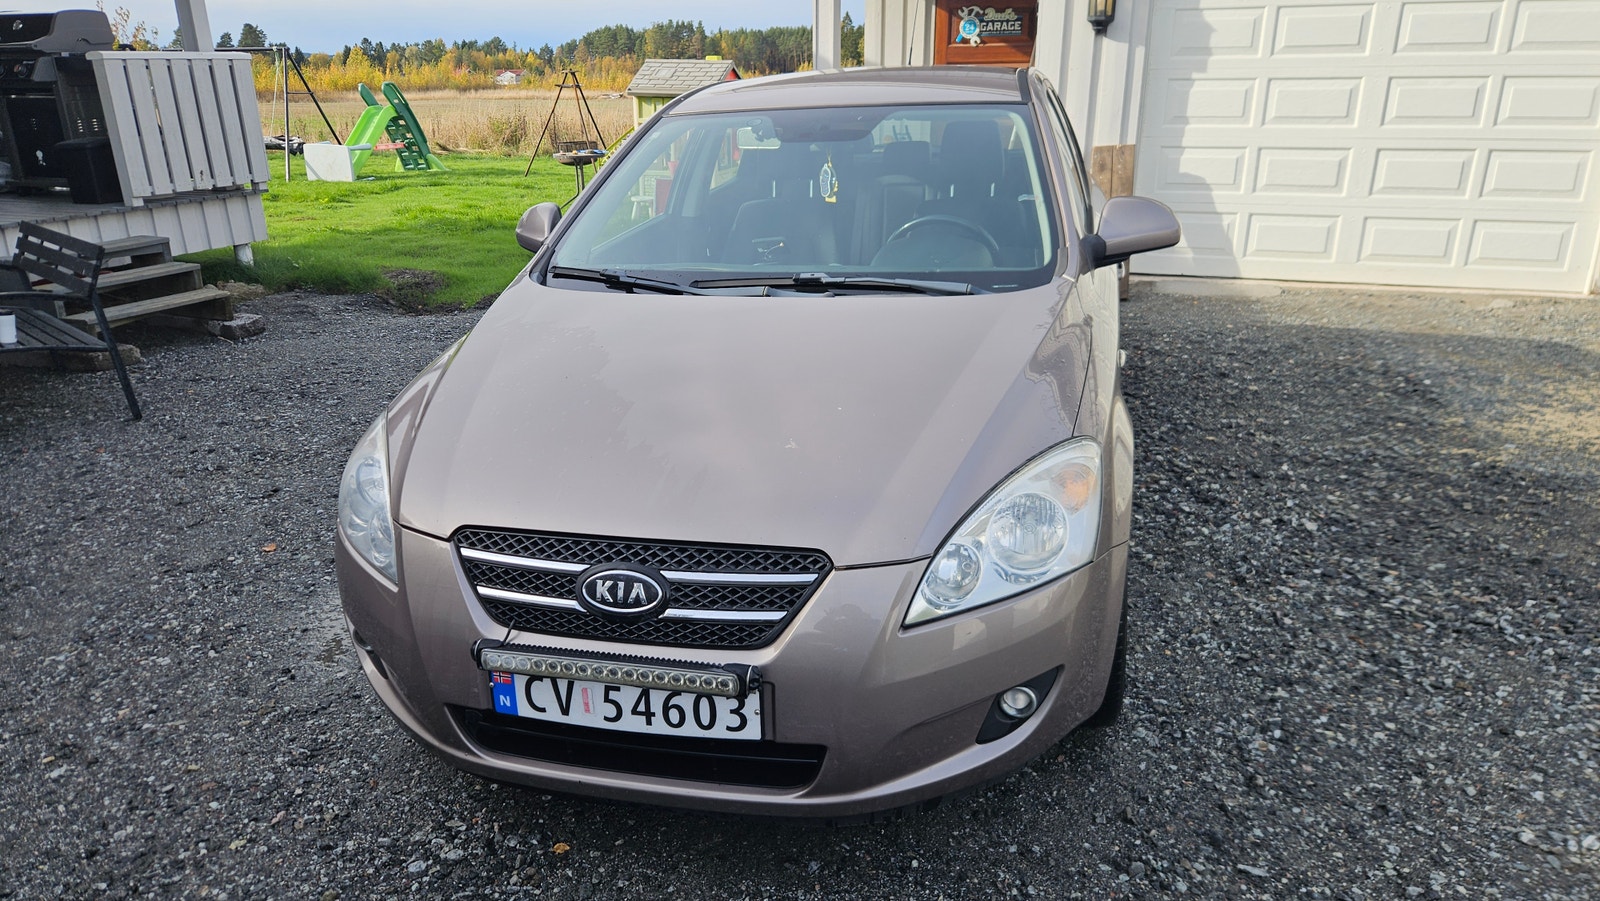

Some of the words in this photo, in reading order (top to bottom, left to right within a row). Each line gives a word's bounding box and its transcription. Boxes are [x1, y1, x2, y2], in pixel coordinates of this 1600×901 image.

[980, 21, 1022, 31] GARAGE
[595, 579, 648, 605] KIA
[499, 693, 511, 708] N
[524, 676, 575, 717] CV
[603, 685, 748, 732] 54603
